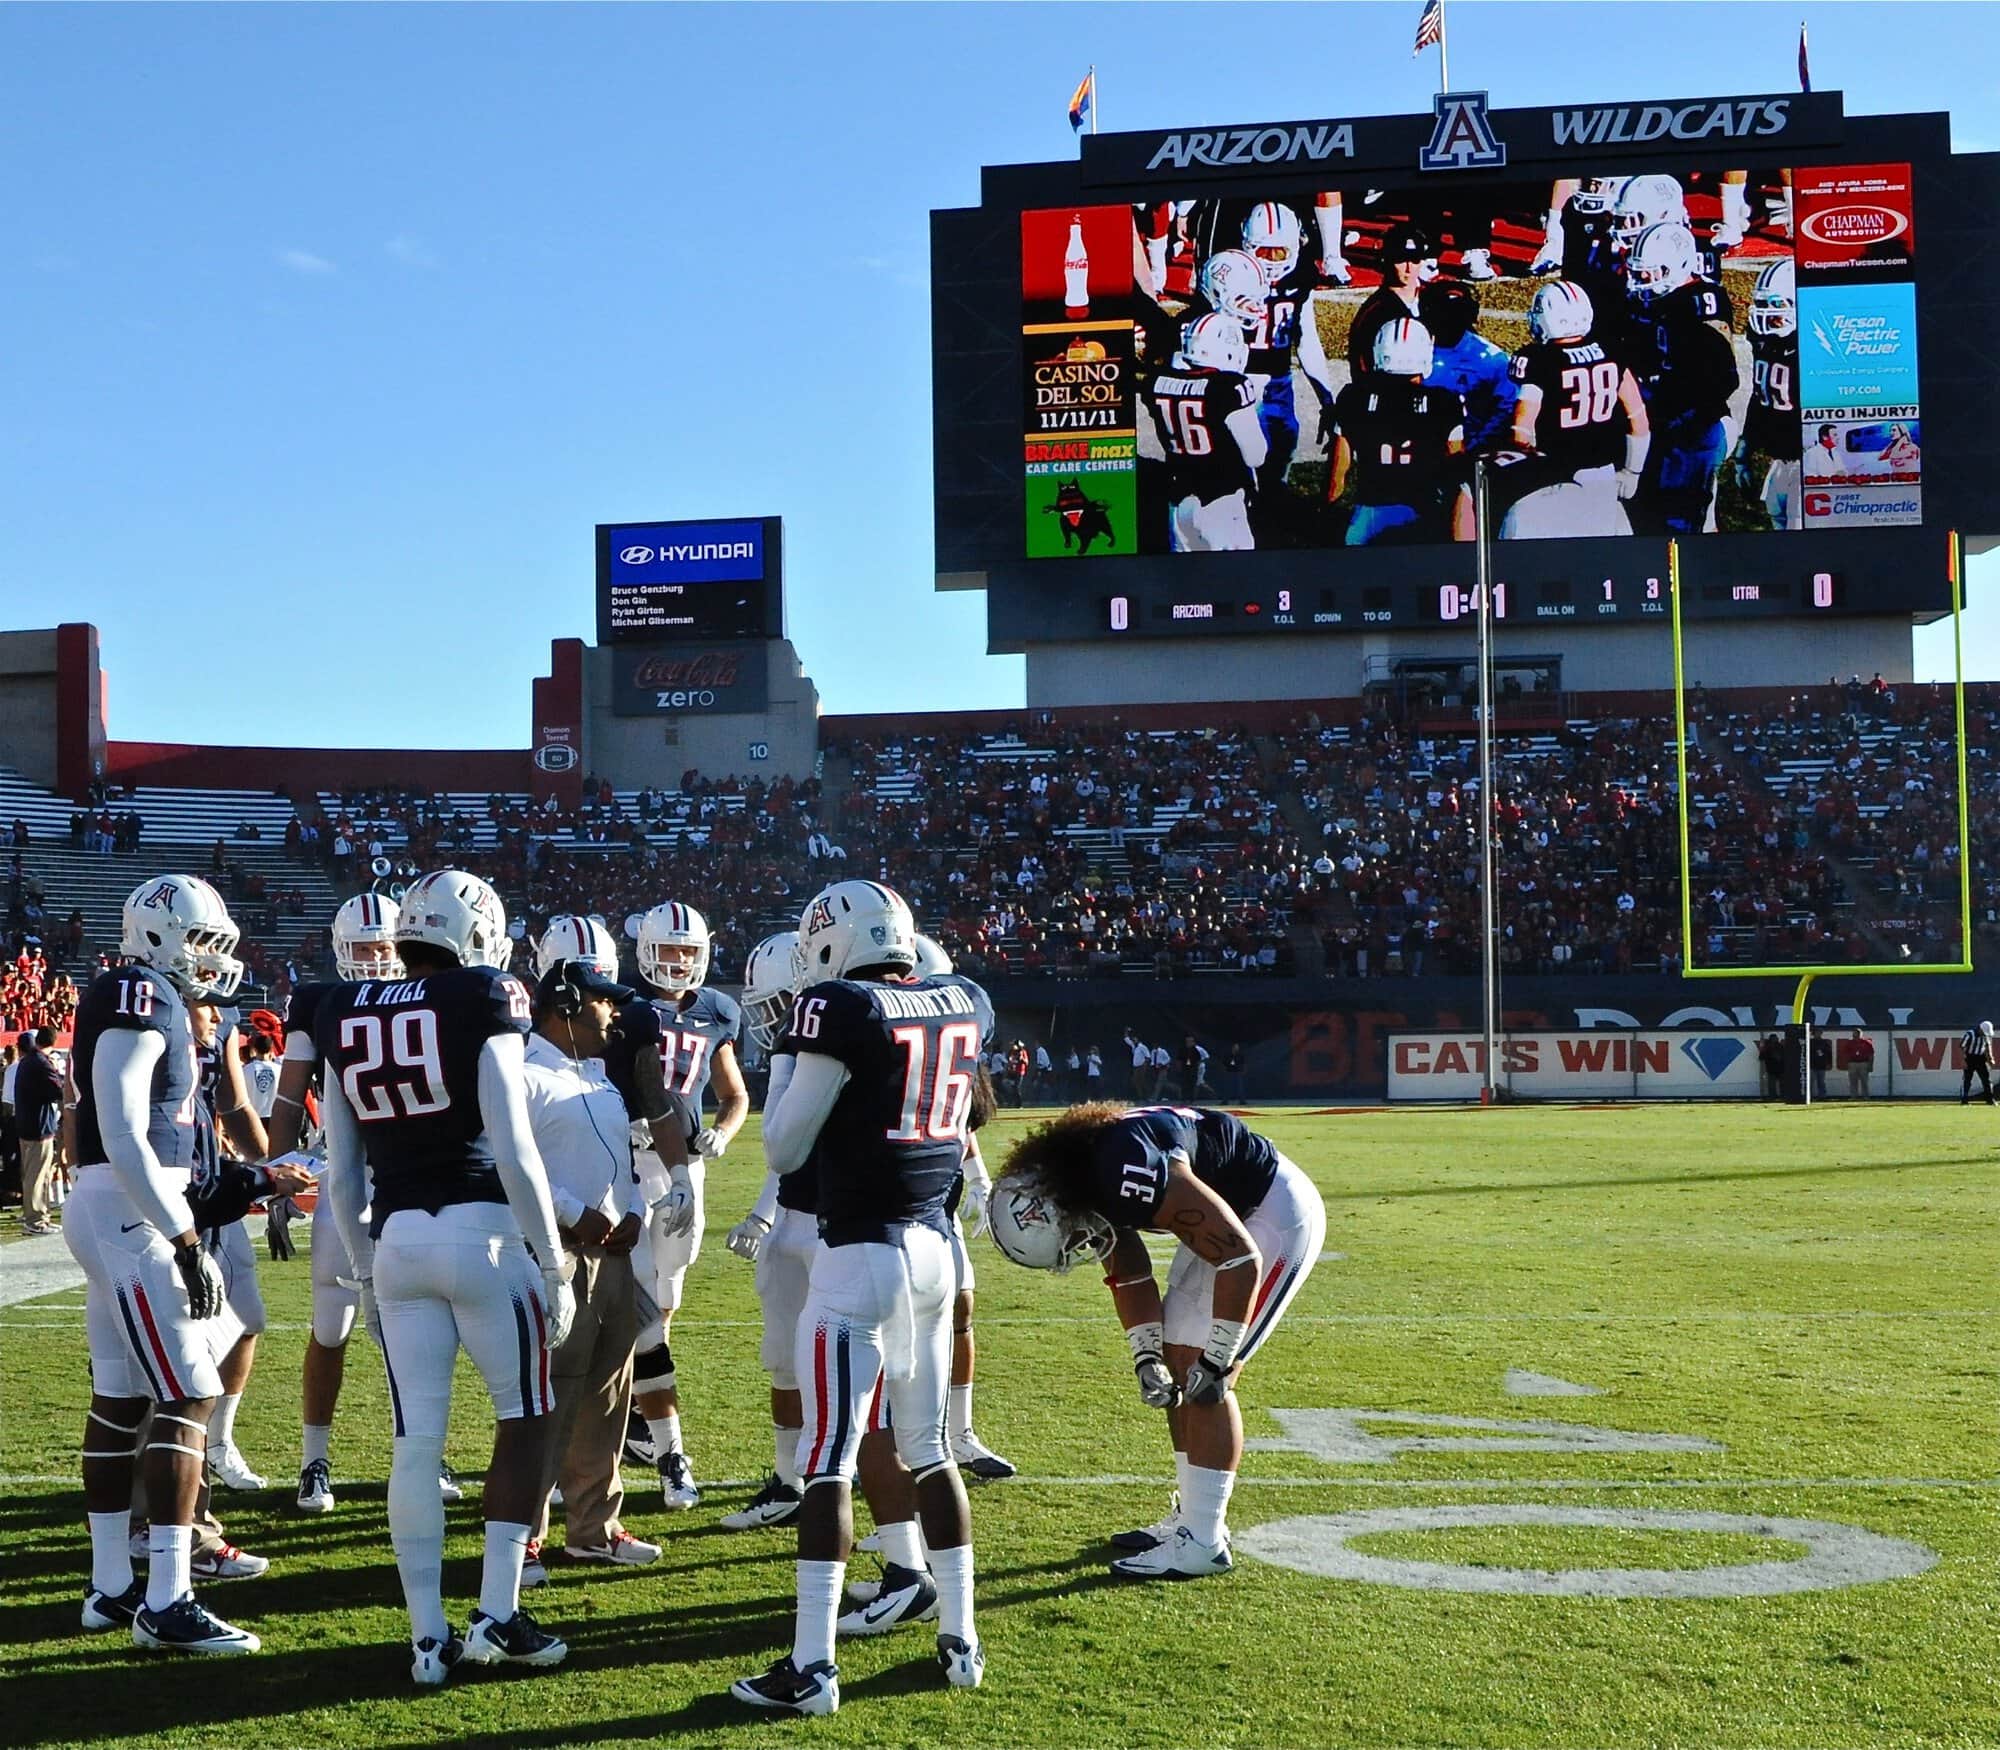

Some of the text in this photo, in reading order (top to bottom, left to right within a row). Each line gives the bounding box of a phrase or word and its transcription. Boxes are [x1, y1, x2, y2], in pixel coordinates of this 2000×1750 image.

[1146, 91, 1791, 170] ARIZONA A WILDCATS
[1823, 213, 1885, 229] CHAPMAN
[1825, 228, 1885, 238] AUTOMOTIVE
[1832, 315, 1886, 329] Tucson
[1838, 327, 1901, 342] Electric
[1844, 341, 1901, 356] Power
[1034, 363, 1121, 385] CASINO
[1036, 384, 1122, 406] DEL SOL
[1559, 362, 1619, 429] 38
[1754, 360, 1793, 411] 99
[1838, 386, 1882, 396] TEP.COM
[1040, 409, 1117, 429] 11/11/11
[1803, 406, 1918, 420] AUTO INJURY?
[1155, 399, 1213, 456] 16
[1026, 461, 1134, 474] CAR CARE CENTERS
[1833, 500, 1918, 516] Chiropractic
[660, 543, 754, 562] HYUNDAI
[611, 586, 638, 595] Bruce
[1602, 579, 1613, 601] 1
[1646, 577, 1659, 599] 3
[1732, 585, 1760, 601] UTAH
[1813, 573, 1833, 607] 0
[611, 596, 648, 606] Don Gin
[1278, 590, 1291, 611] 3
[1537, 605, 1575, 616] BALL ON
[611, 607, 665, 618] Ryan Girton
[1110, 597, 1128, 630] 0
[1172, 604, 1214, 619] ARIZONA
[1314, 613, 1342, 623] DOWN
[1363, 611, 1392, 622] TO GO
[611, 617, 646, 627] Michael
[656, 690, 714, 708] zero
[750, 743, 768, 759] 10
[144, 883, 179, 914] A
[808, 896, 837, 936] A
[115, 979, 155, 1017] 18
[375, 978, 428, 1006] HILL
[788, 996, 828, 1039] 16
[340, 1008, 451, 1121] 29
[1394, 1038, 1670, 1075] CATS WIN
[885, 1021, 979, 1143] 16
[1119, 1163, 1158, 1204] 31
[1011, 1195, 1050, 1232] A
